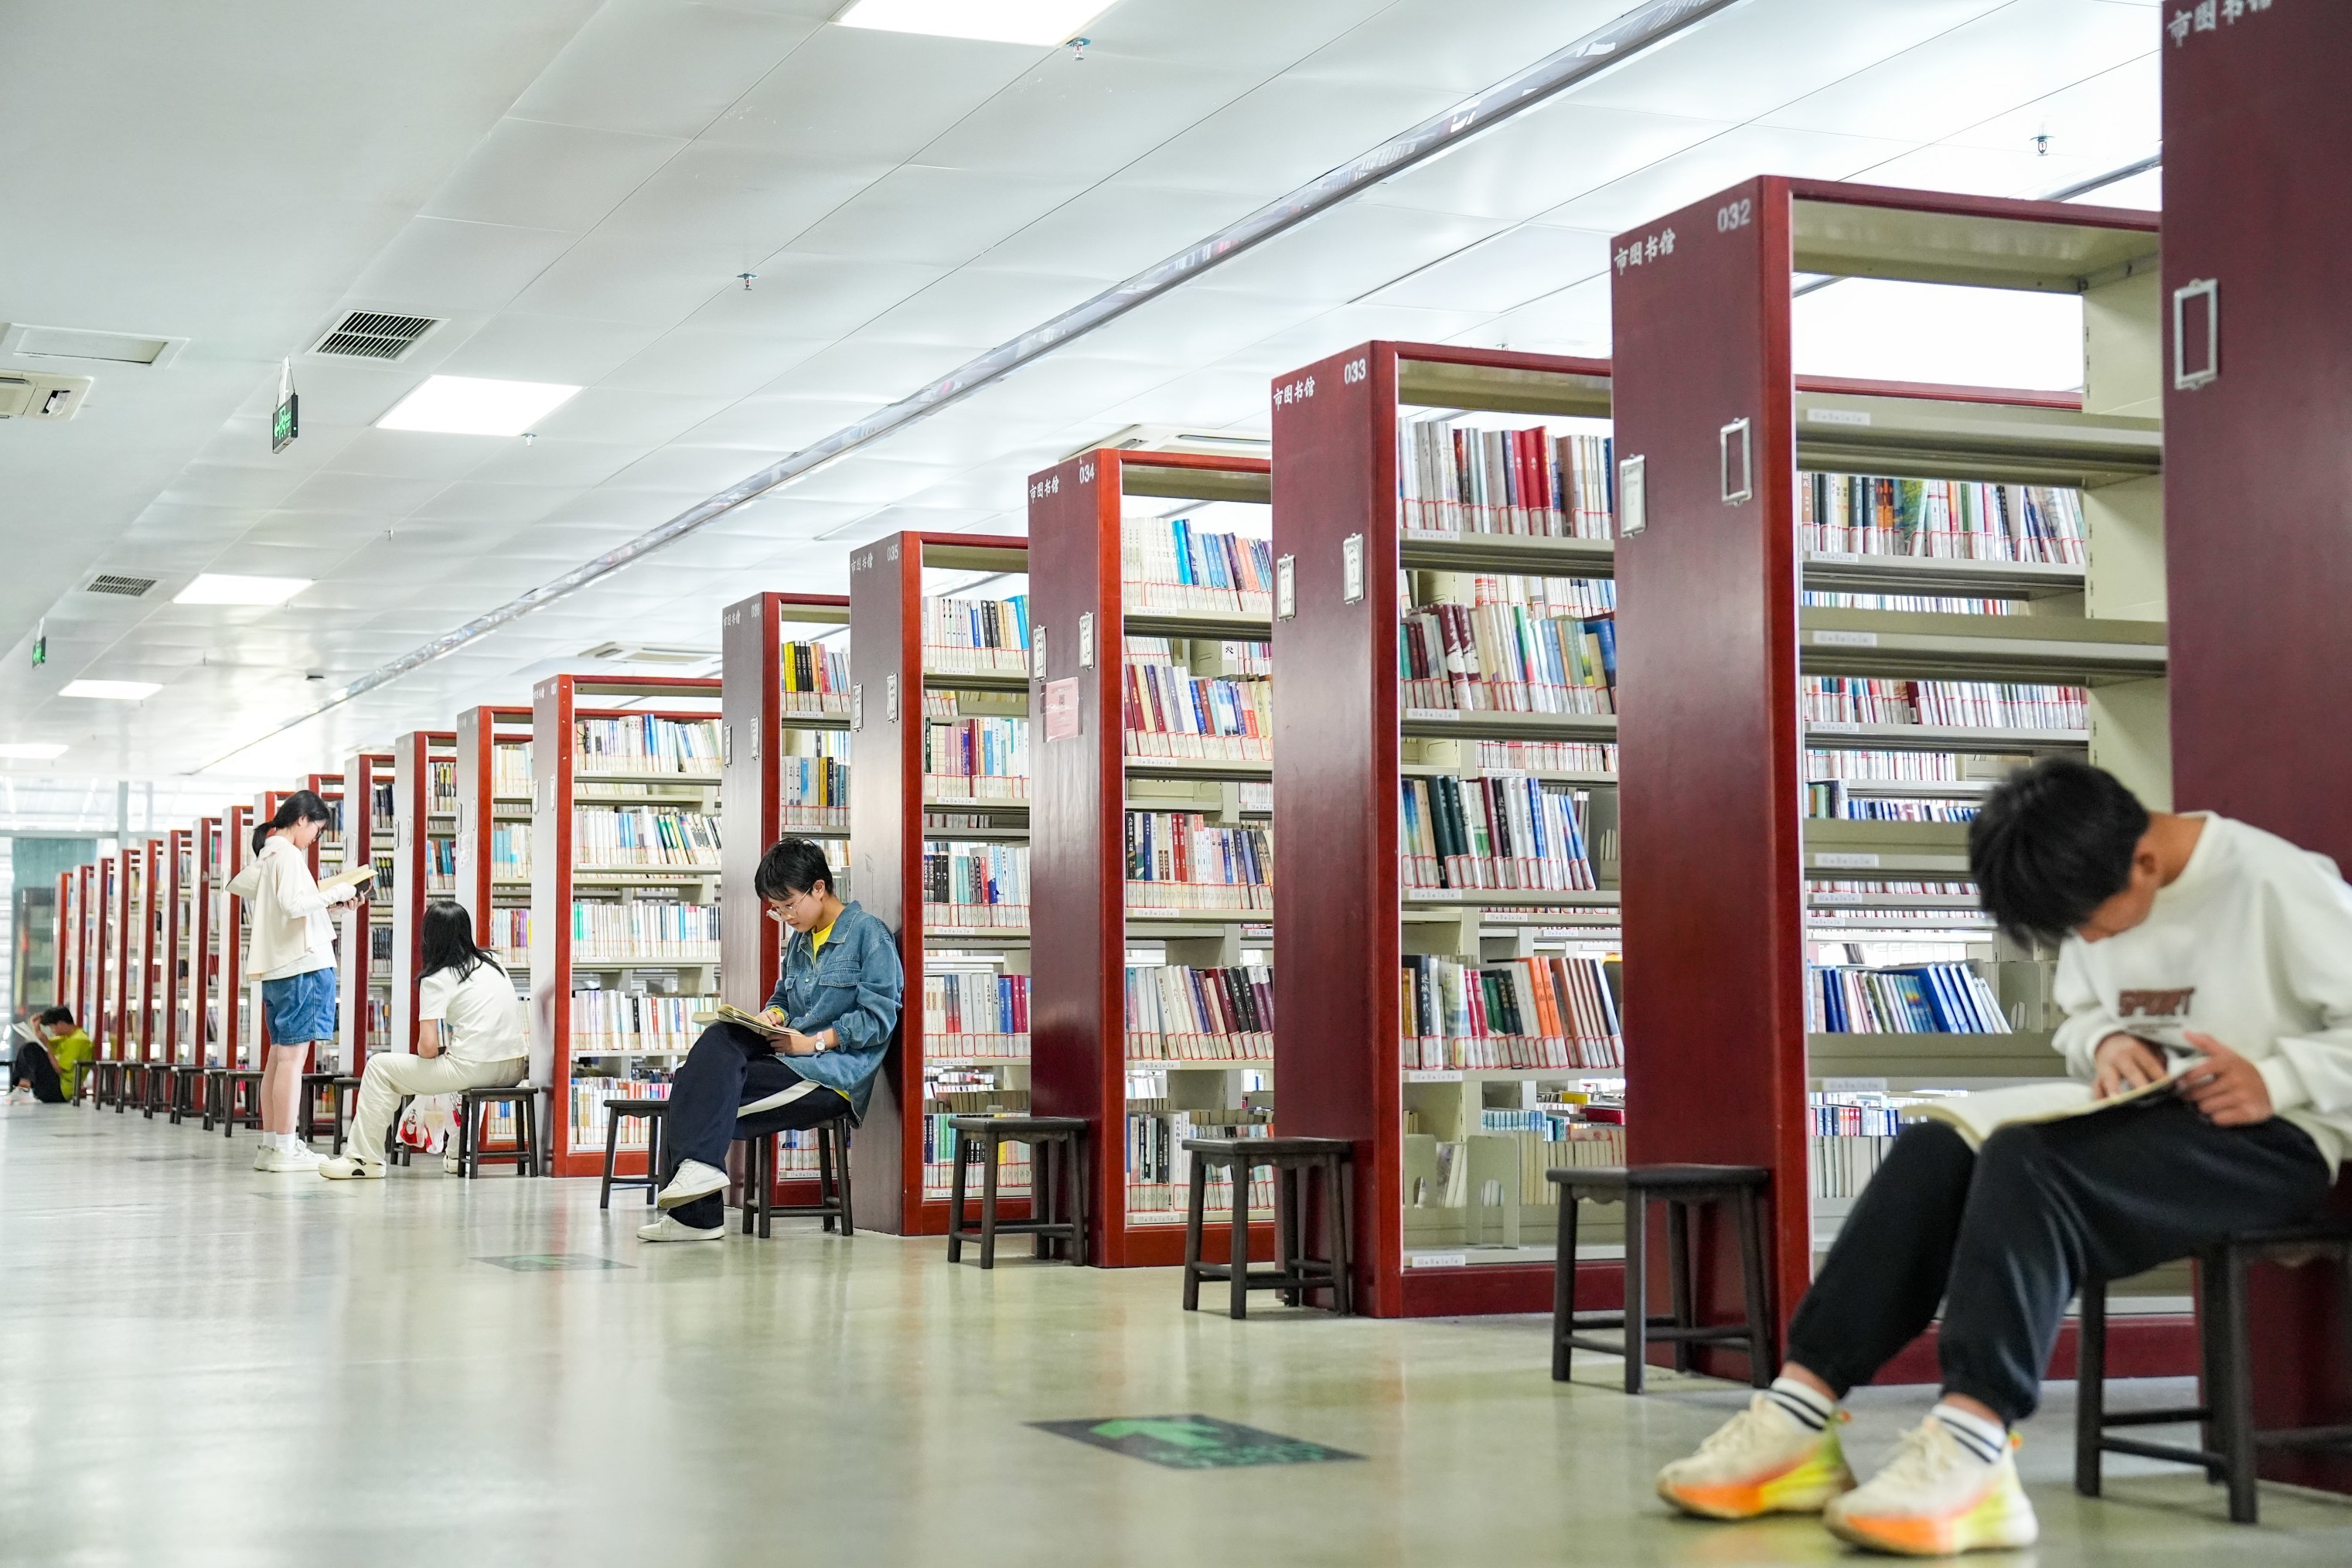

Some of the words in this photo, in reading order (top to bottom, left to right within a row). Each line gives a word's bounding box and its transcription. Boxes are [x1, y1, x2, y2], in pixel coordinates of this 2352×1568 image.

[1614, 228, 1676, 275] 市图书馆
[1717, 198, 1751, 232] 032
[1273, 376, 1315, 411] 市图书馆
[1345, 359, 1366, 384] 033
[1030, 475, 1059, 503] 市图书馆
[1079, 463, 1095, 484] 034
[851, 552, 873, 575] 市图书馆
[887, 544, 898, 561] 035
